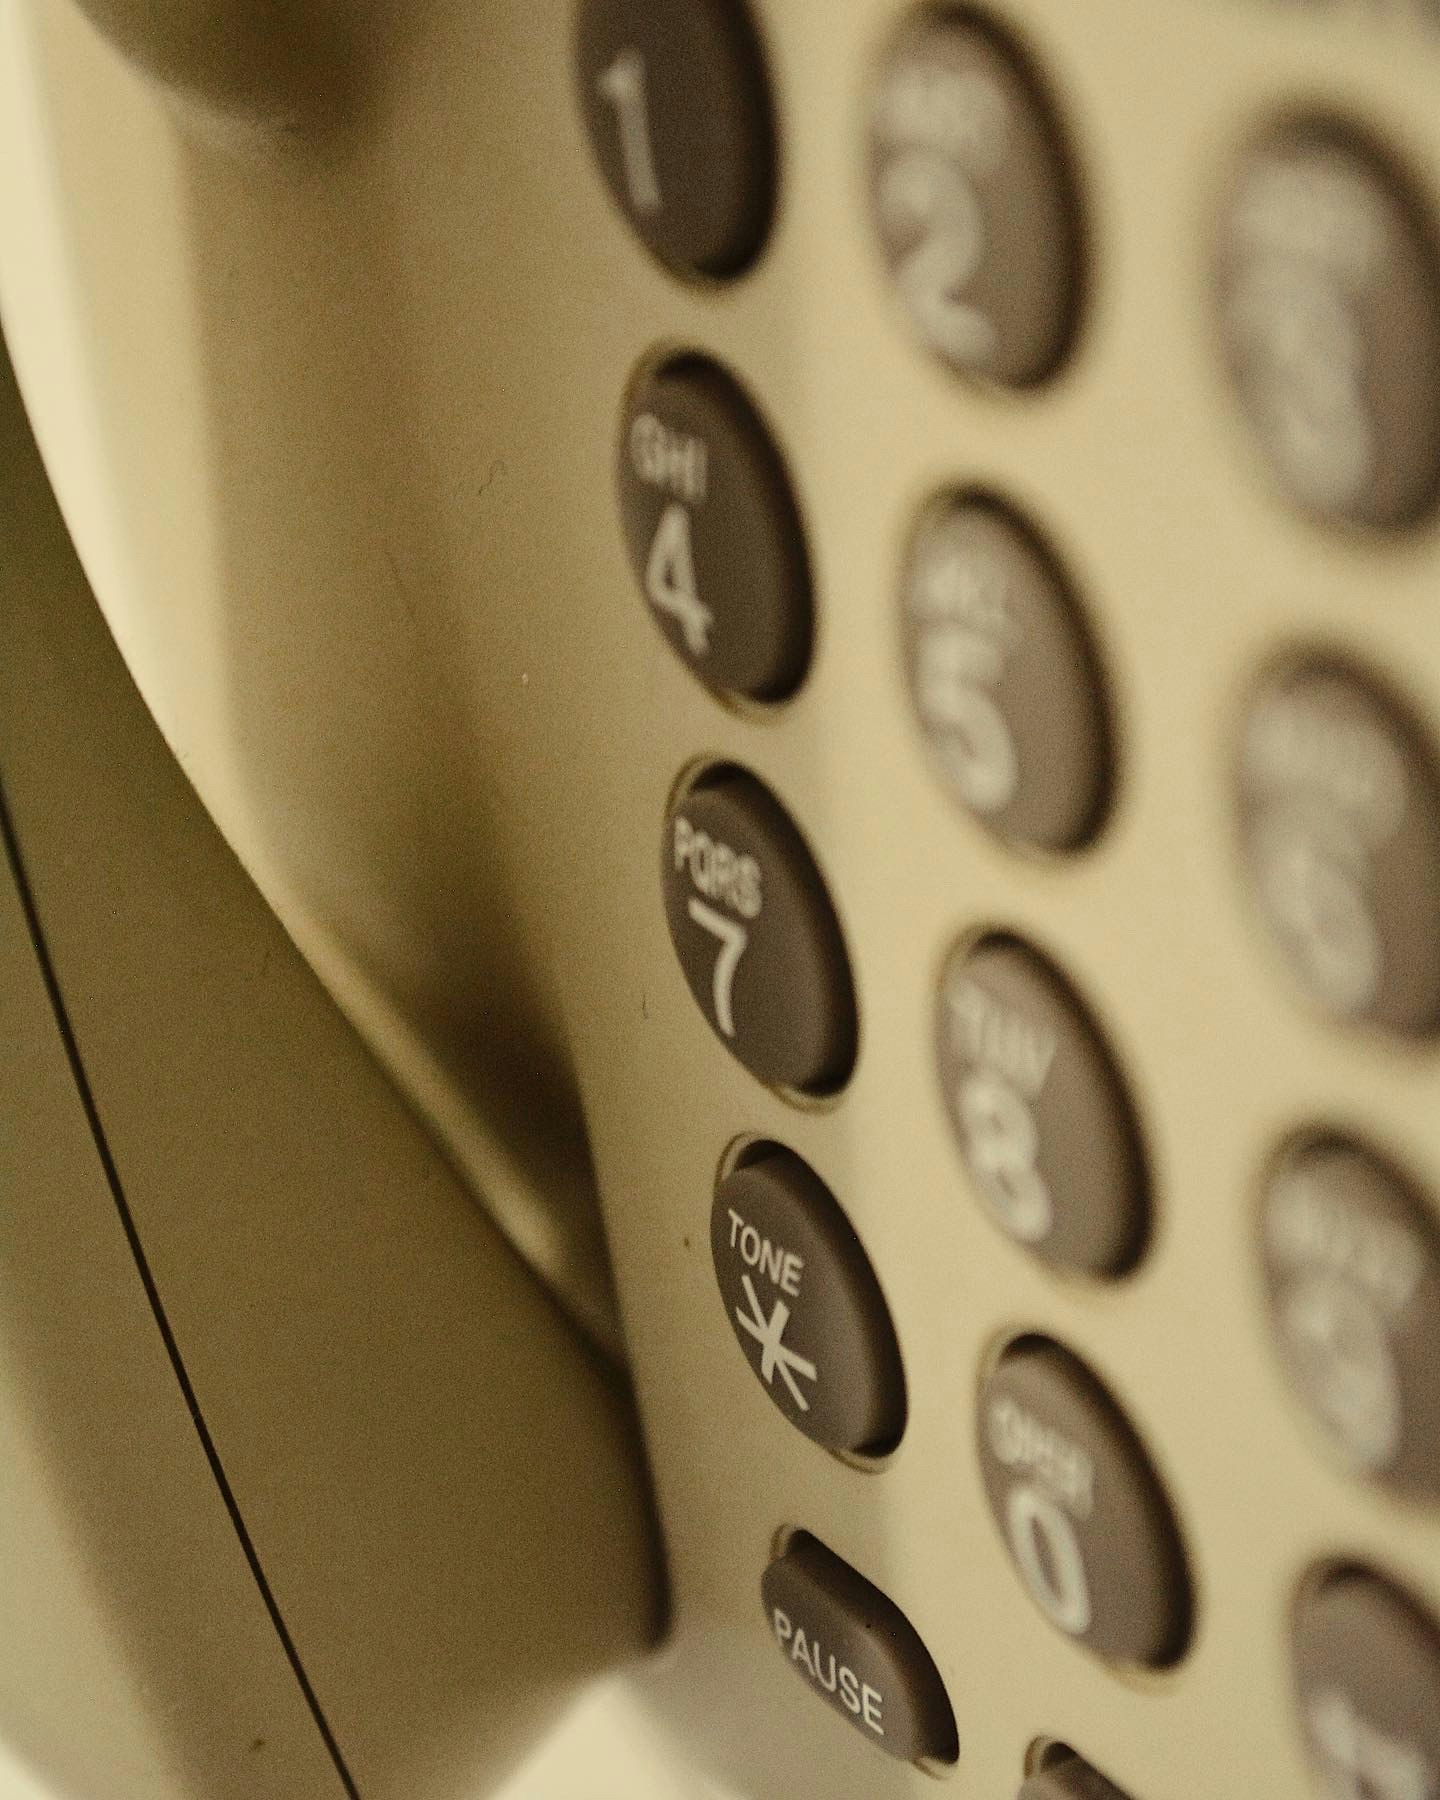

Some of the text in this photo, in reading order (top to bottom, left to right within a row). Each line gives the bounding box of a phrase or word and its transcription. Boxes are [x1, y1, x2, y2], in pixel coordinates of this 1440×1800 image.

[600, 50, 662, 214] 1
[878, 150, 998, 362] 2
[646, 503, 714, 655] 4
[688, 898, 747, 1038] 7
[960, 1078, 1050, 1242] 8
[728, 1208, 804, 1297] TONE
[1006, 1488, 1091, 1636] 0
[774, 1608, 885, 1736] PAUSE
